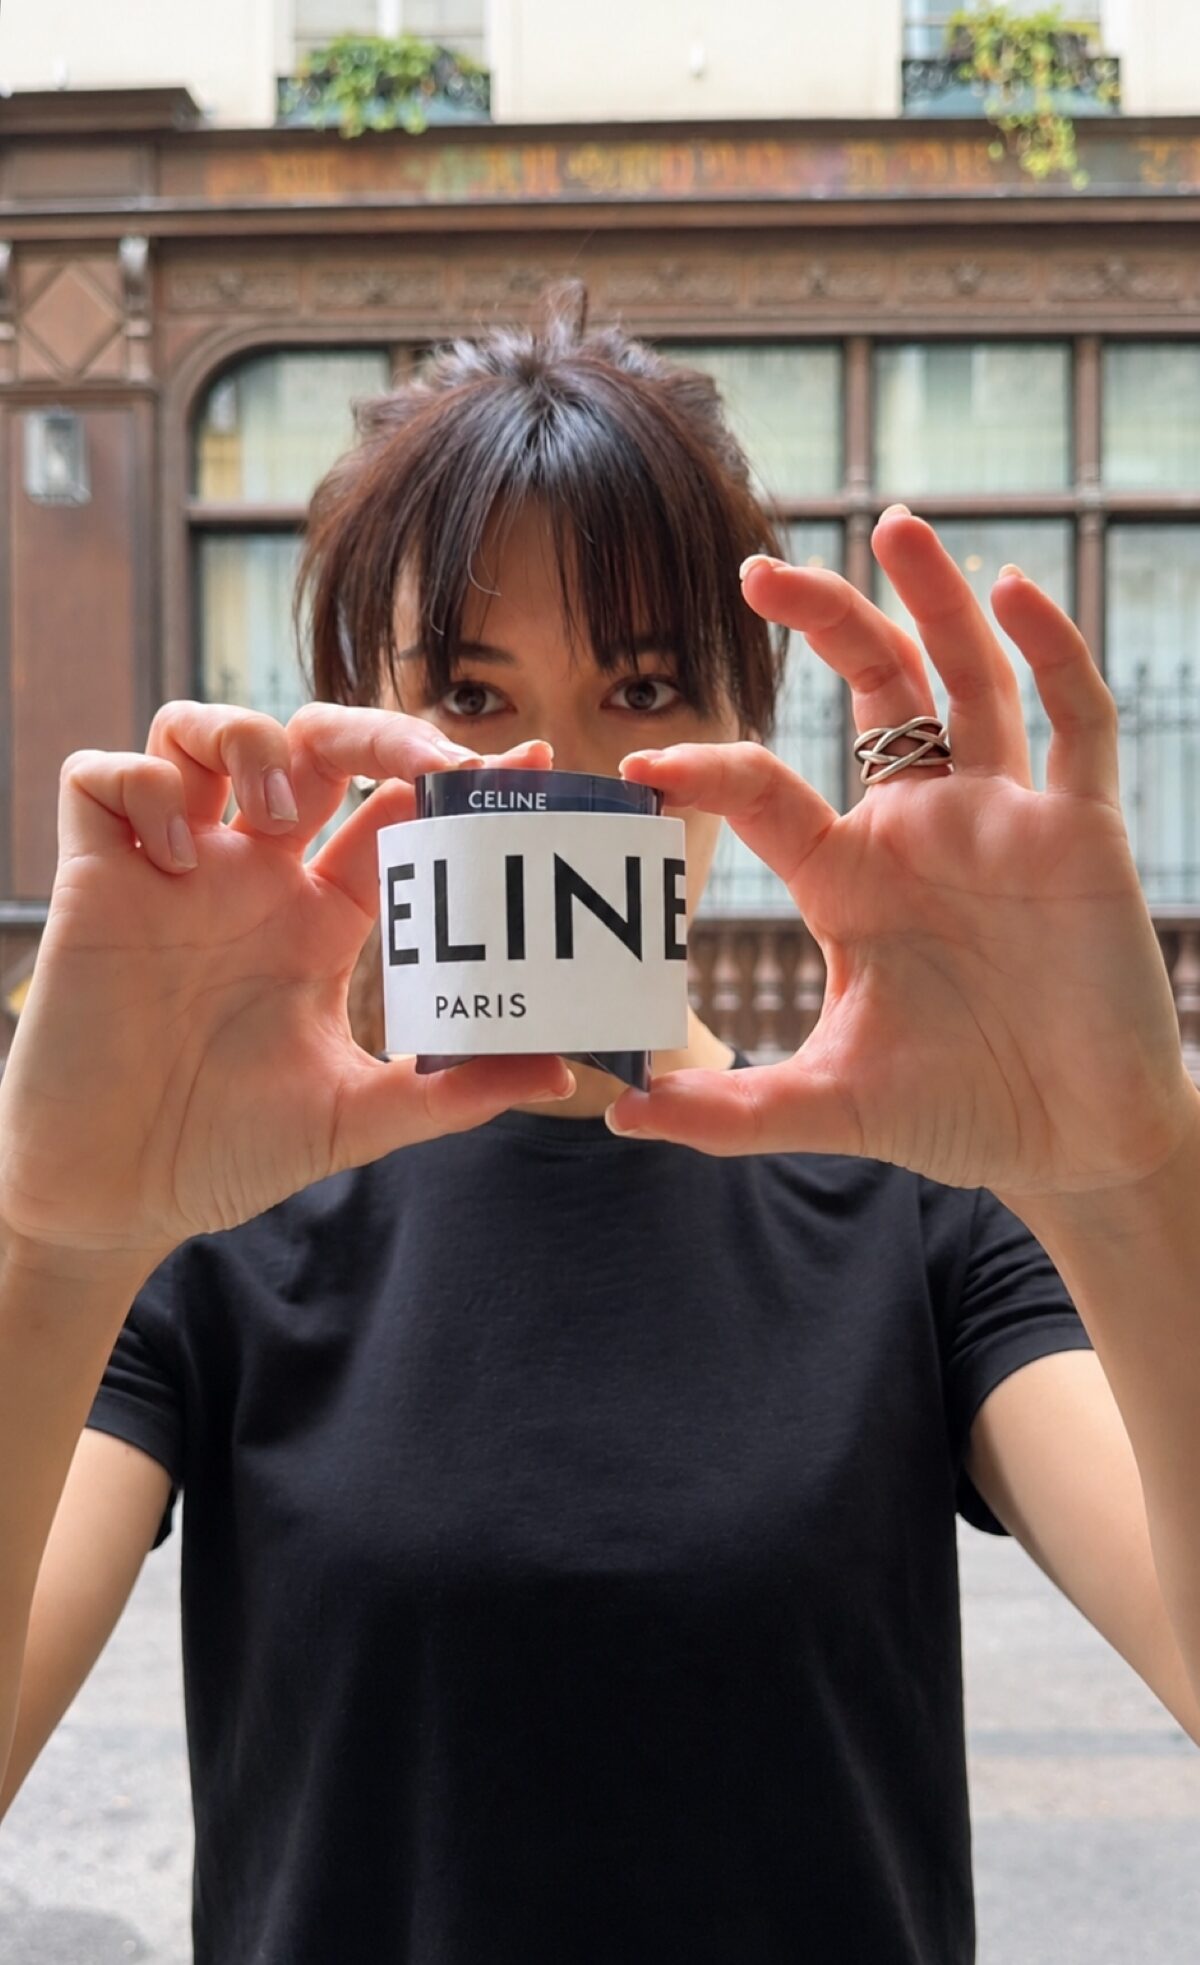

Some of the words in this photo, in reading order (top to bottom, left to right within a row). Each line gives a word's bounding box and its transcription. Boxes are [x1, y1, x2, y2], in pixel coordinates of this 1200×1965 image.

[468, 790, 547, 811] CELINE
[379, 852, 688, 966] ELINE
[435, 993, 527, 1019] PARIS
